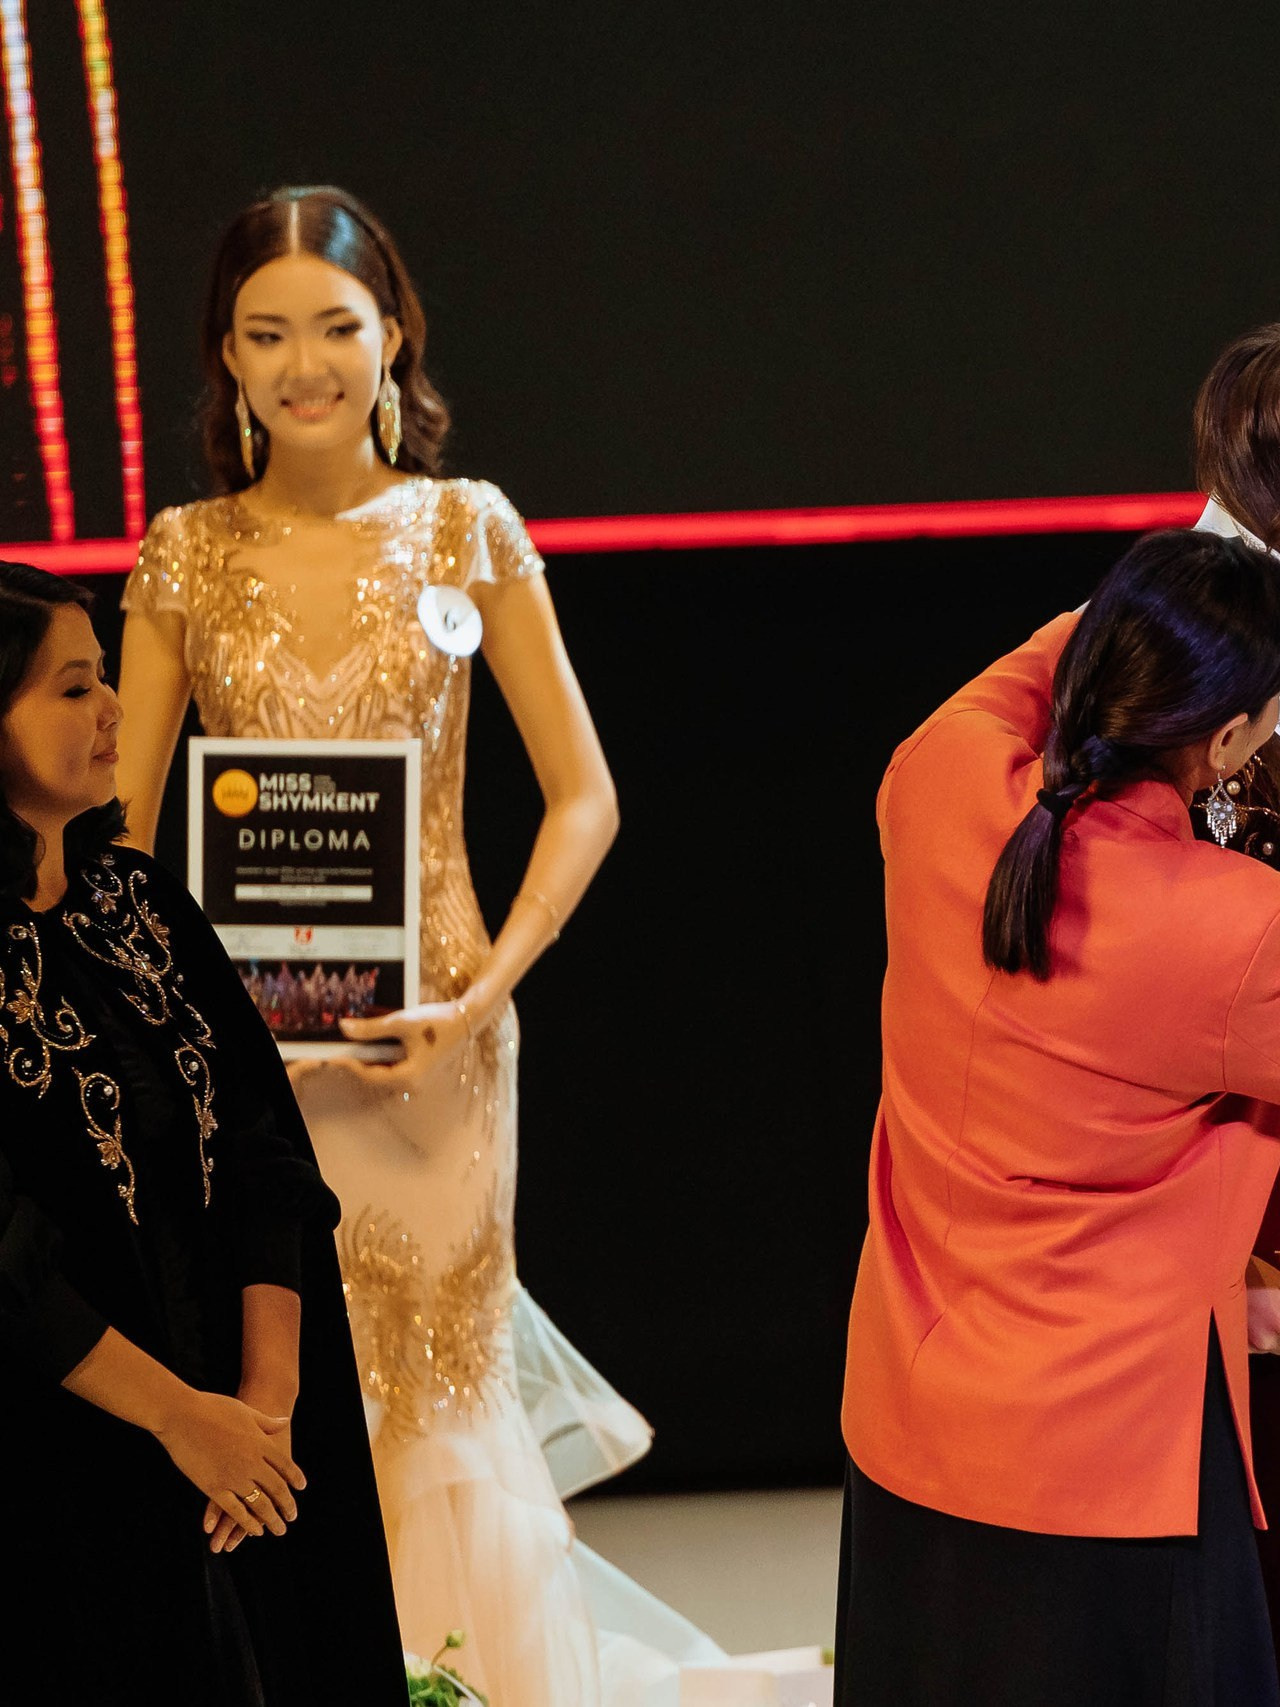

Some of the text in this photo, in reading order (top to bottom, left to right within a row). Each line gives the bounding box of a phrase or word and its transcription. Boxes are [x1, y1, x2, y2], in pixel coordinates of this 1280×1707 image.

[259, 772, 311, 792] MISS
[259, 792, 380, 813] SHYMKENT
[239, 828, 371, 851] DIPLOMA
